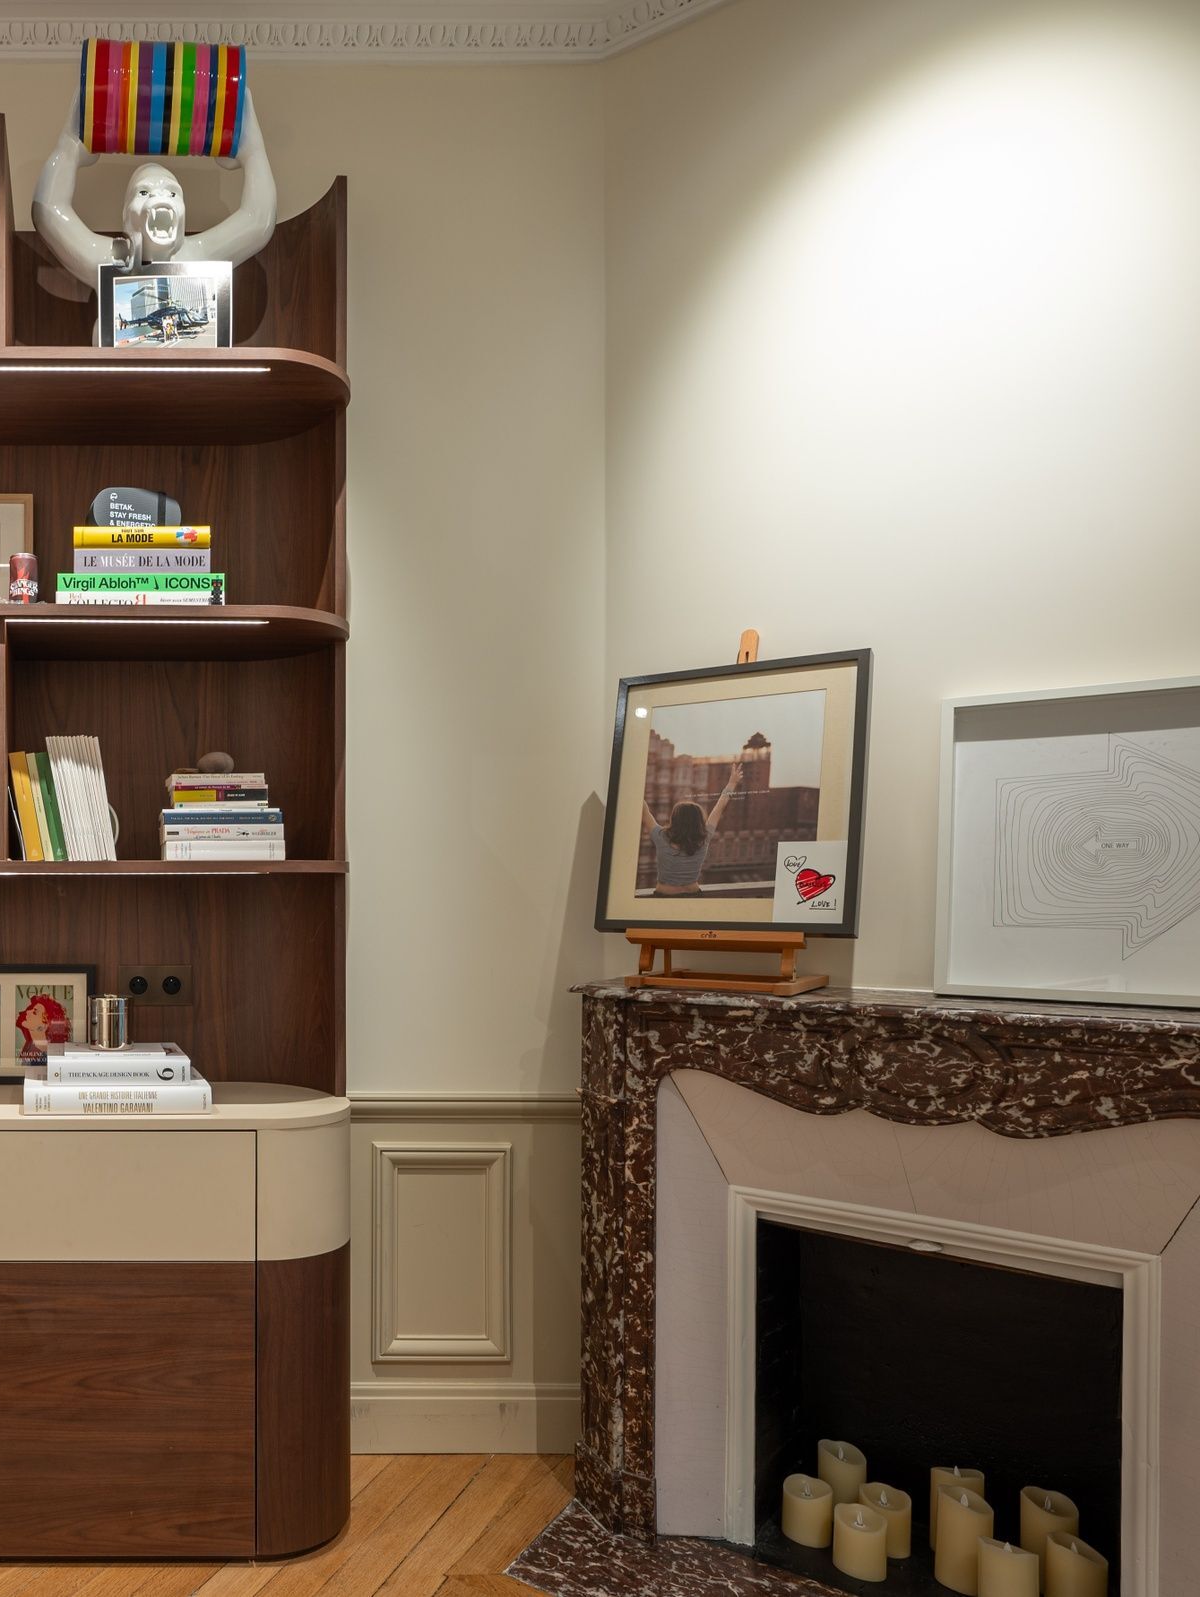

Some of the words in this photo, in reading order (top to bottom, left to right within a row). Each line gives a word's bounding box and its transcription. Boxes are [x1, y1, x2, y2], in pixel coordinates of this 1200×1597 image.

[110, 503, 135, 511] BETAK.
[112, 534, 123, 542] LA
[126, 534, 154, 542] MODE
[84, 556, 97, 566] LE
[100, 553, 135, 566] MUSÉE
[139, 556, 153, 566] DE
[156, 556, 170, 566] LA
[175, 556, 206, 566] MODE
[62, 577, 96, 591] Virgil
[165, 578, 210, 589] ICONS
[16, 986, 74, 1000] VOGUE
[79, 1091, 88, 1099] UNE
[89, 1091, 108, 1099] GRANDE
[111, 1091, 132, 1099] HISTOIRE
[134, 1091, 157, 1099] ITALIENNE
[83, 1103, 118, 1113] VALENTINO
[120, 1103, 153, 1113] GARAVANI
